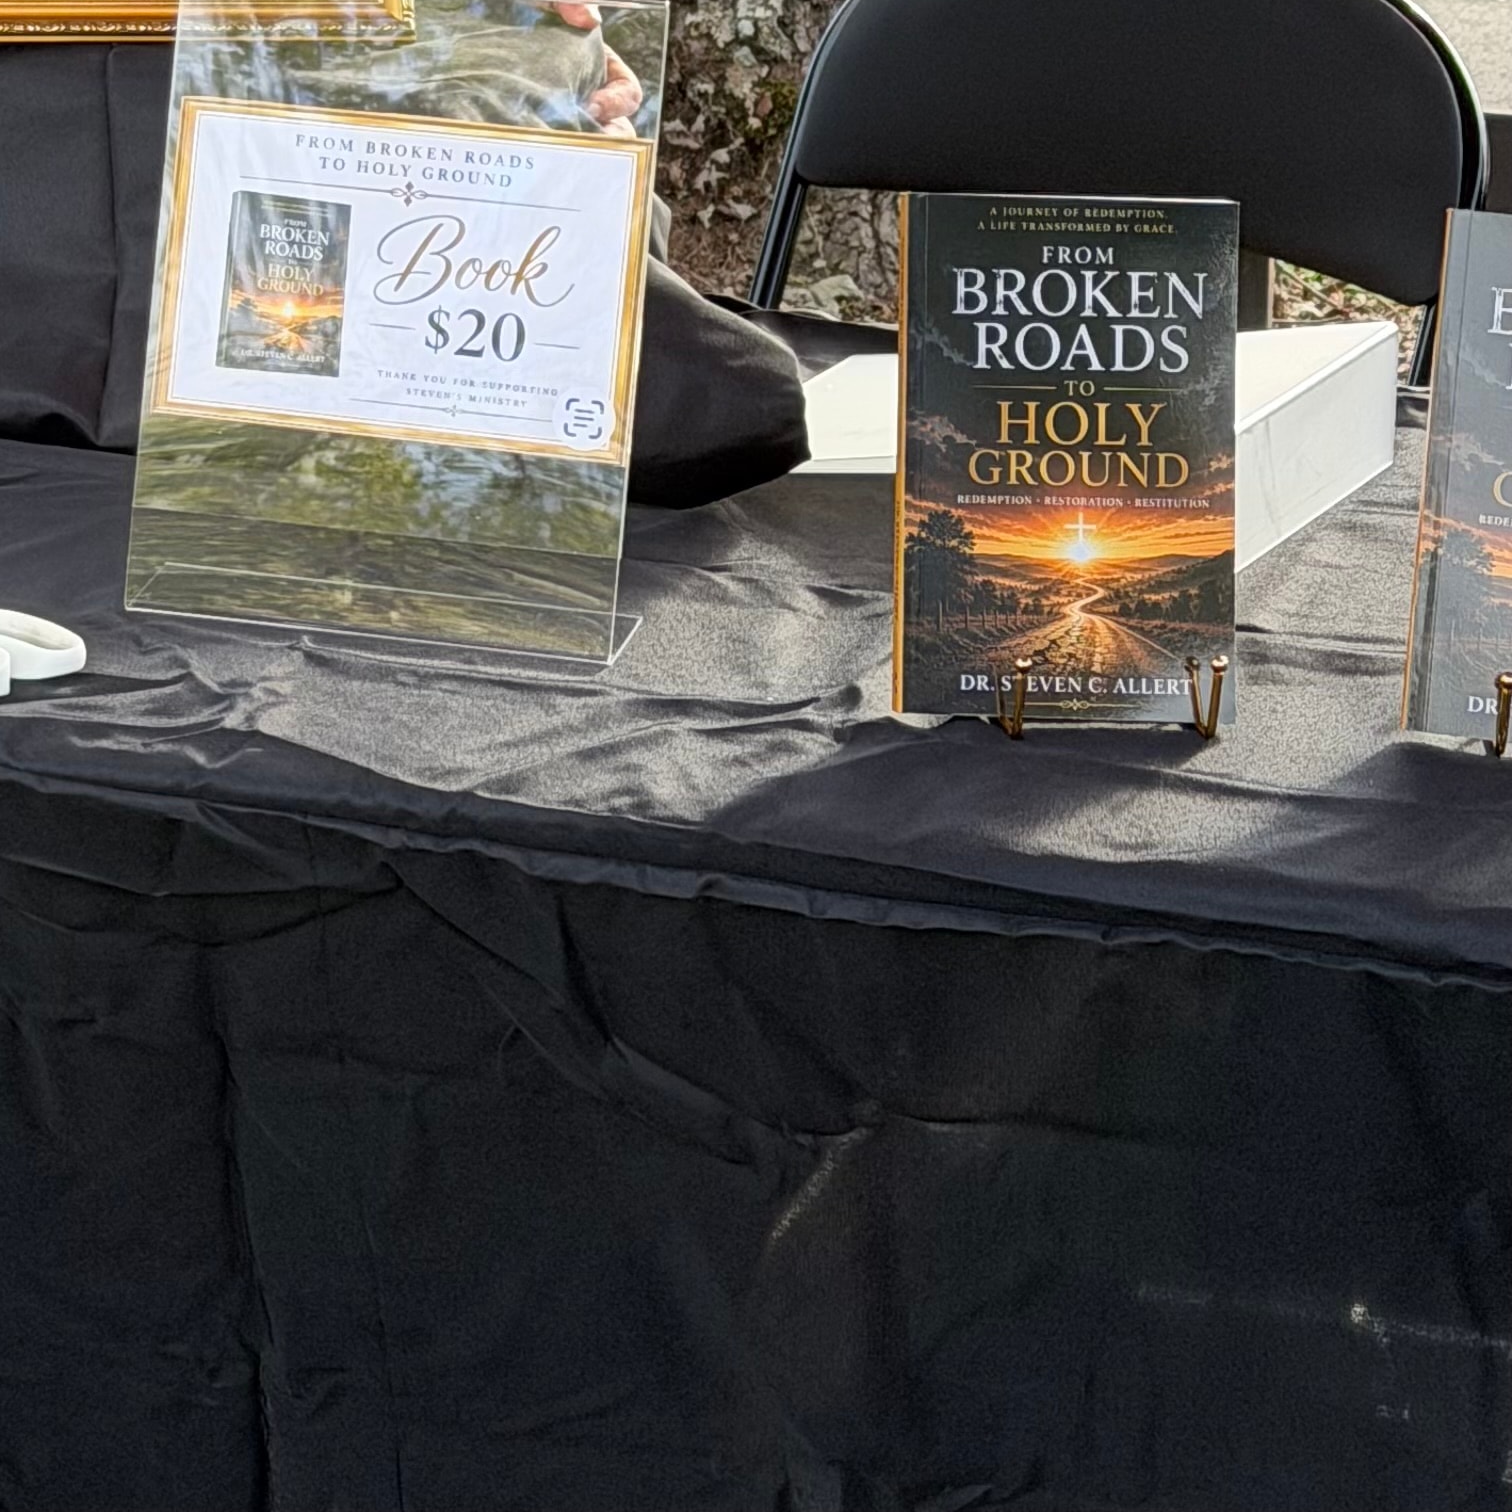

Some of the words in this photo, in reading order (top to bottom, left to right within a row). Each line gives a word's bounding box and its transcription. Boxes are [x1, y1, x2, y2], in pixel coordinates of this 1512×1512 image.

[295, 134, 354, 152] FROM
[366, 141, 453, 161] BROKEN
[465, 151, 535, 170] ROADS
[319, 156, 346, 171] TO
[357, 160, 412, 178] HOLY
[422, 167, 513, 188] GROUND
[989, 207, 997, 216] A
[1003, 207, 1059, 217] JOURNEY
[1063, 208, 1079, 217] OF
[260, 224, 330, 246] BROKEN
[977, 221, 985, 230] A
[990, 221, 1016, 230] LIFE
[1021, 221, 1111, 232] TRANSFORMED
[1115, 223, 1129, 233] BY
[265, 240, 323, 261] ROADS
[373, 214, 575, 308] Book
[1042, 246, 1115, 265] FROM
[268, 263, 313, 282] HOLY
[257, 277, 324, 297] GROUND
[952, 267, 1208, 320] BROKEN
[425, 305, 526, 362] $20
[972, 322, 1189, 373] ROADS
[377, 369, 417, 381] THANK
[424, 375, 447, 385] YOU
[453, 378, 476, 388] FOR
[482, 381, 558, 397] SUPPORTING
[1064, 380, 1095, 397] TO
[406, 388, 462, 401] STEVEN'S
[469, 395, 528, 408] MINISTRY
[996, 400, 1167, 447] HOLY
[968, 449, 1190, 489] GROUND
[957, 494, 1032, 506] REDEMPTION
[1044, 496, 1124, 508] RESTORATION
[1135, 498, 1210, 510] RESTITUTION
[960, 674, 995, 692] DR.
[1088, 677, 1108, 695] C.
[1112, 677, 1193, 696] ALLERT
